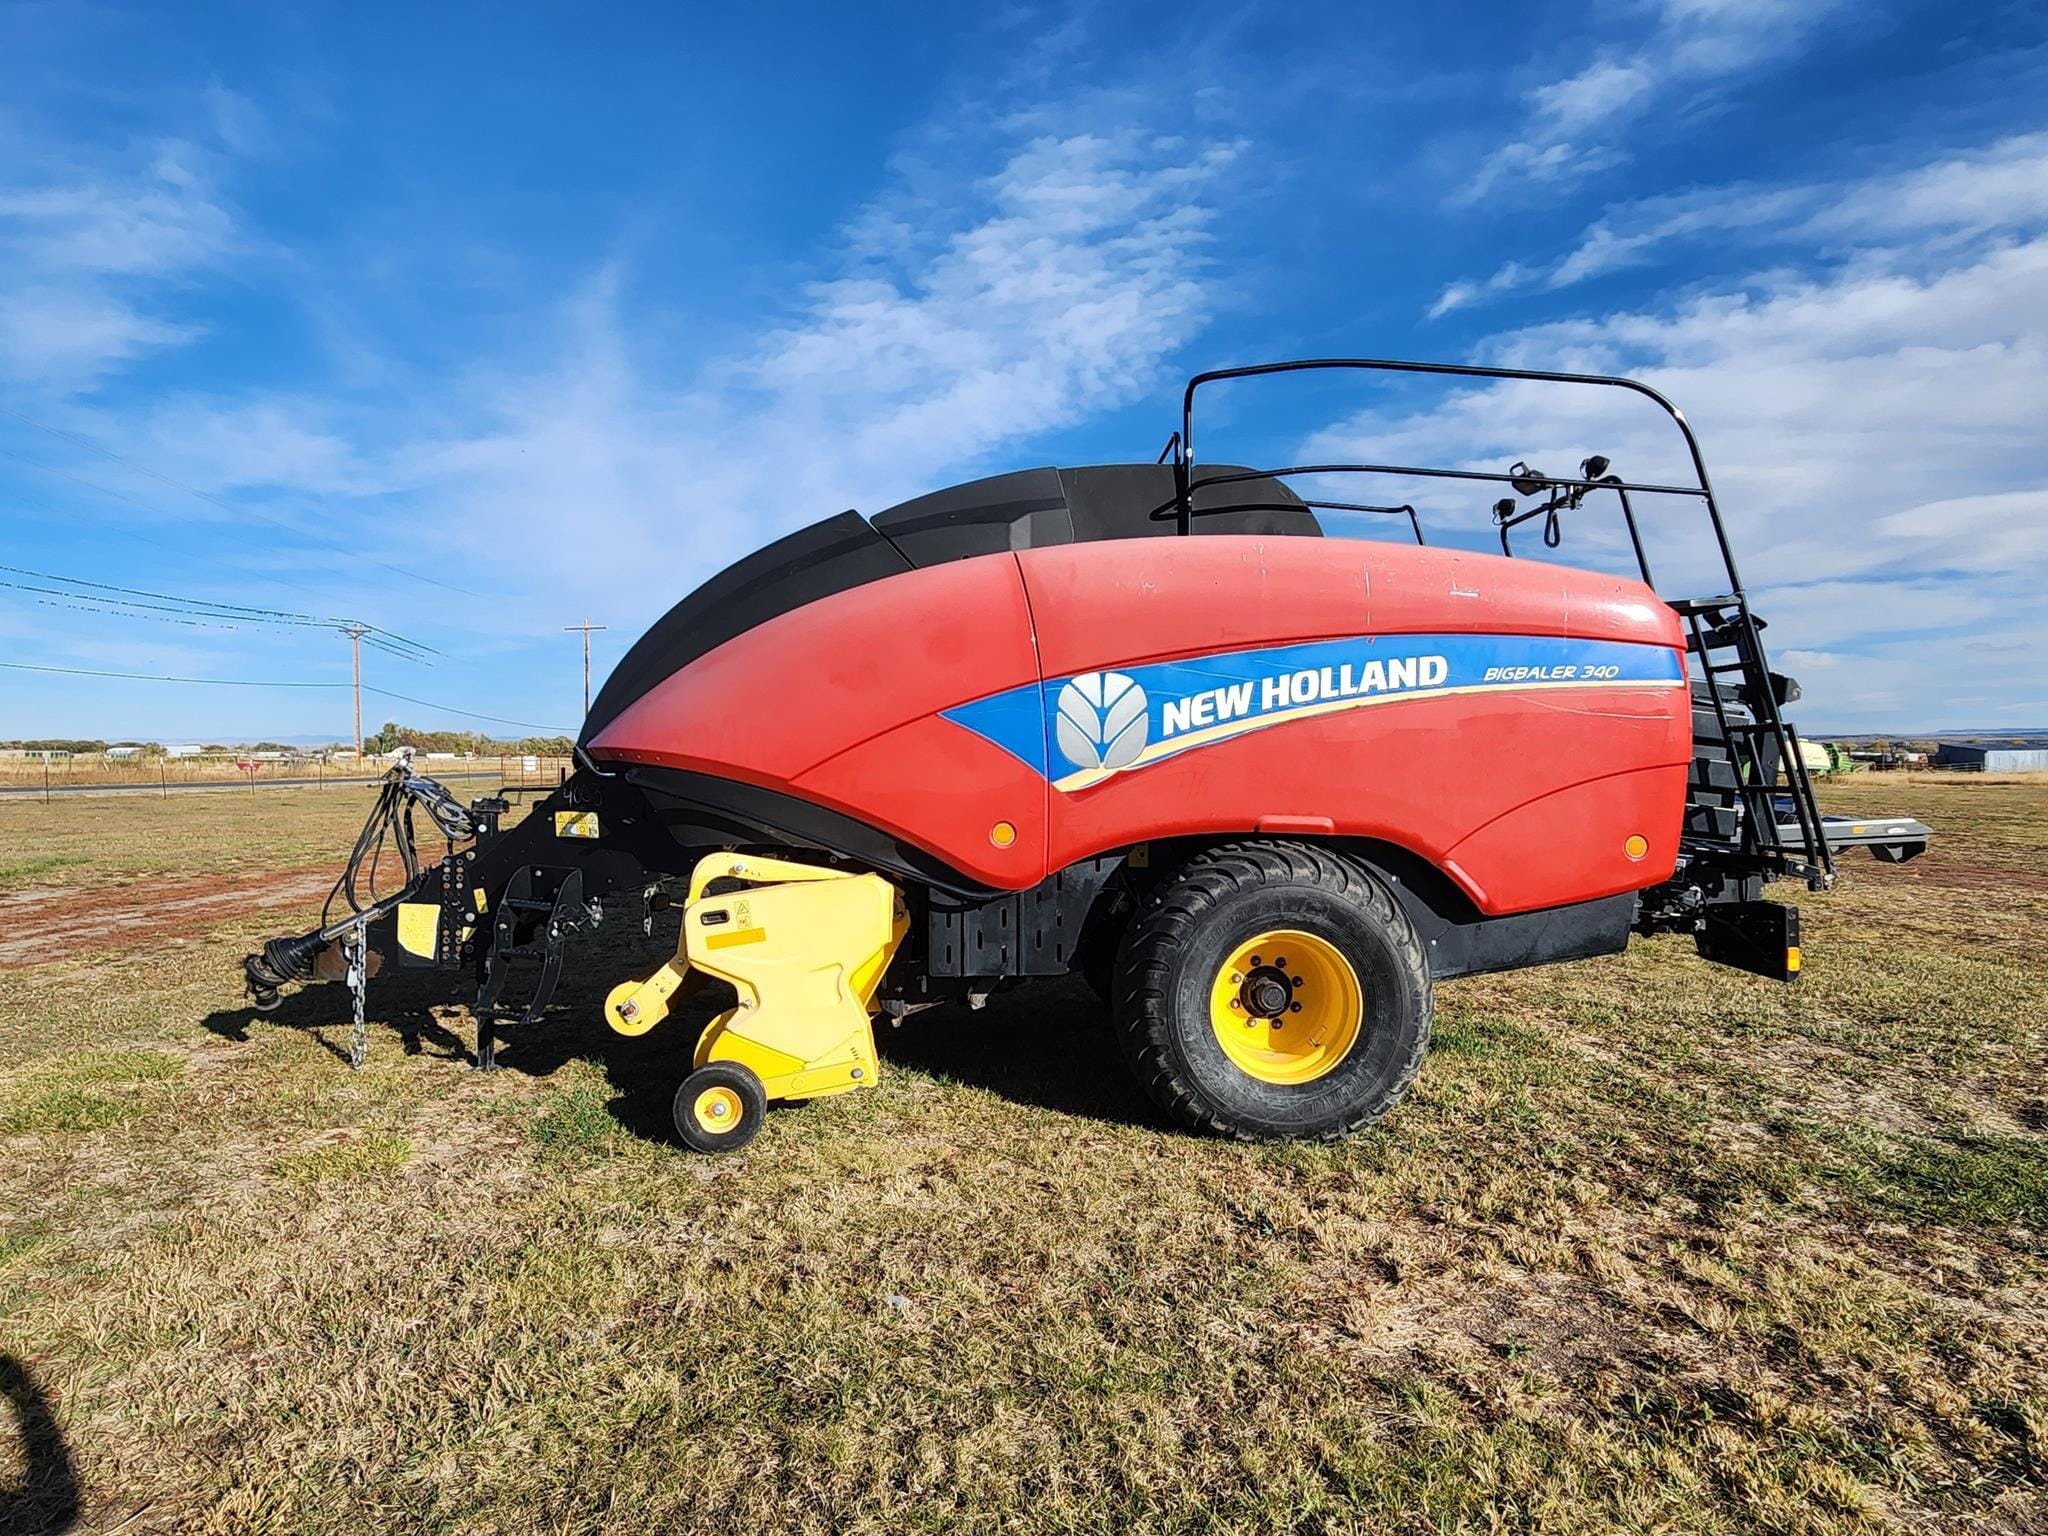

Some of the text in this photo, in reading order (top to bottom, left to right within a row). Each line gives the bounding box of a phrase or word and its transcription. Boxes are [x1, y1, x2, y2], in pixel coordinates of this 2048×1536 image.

[1163, 655, 1449, 736] NEW HOLLAND
[1484, 665, 1619, 681] BIGBALER 340
